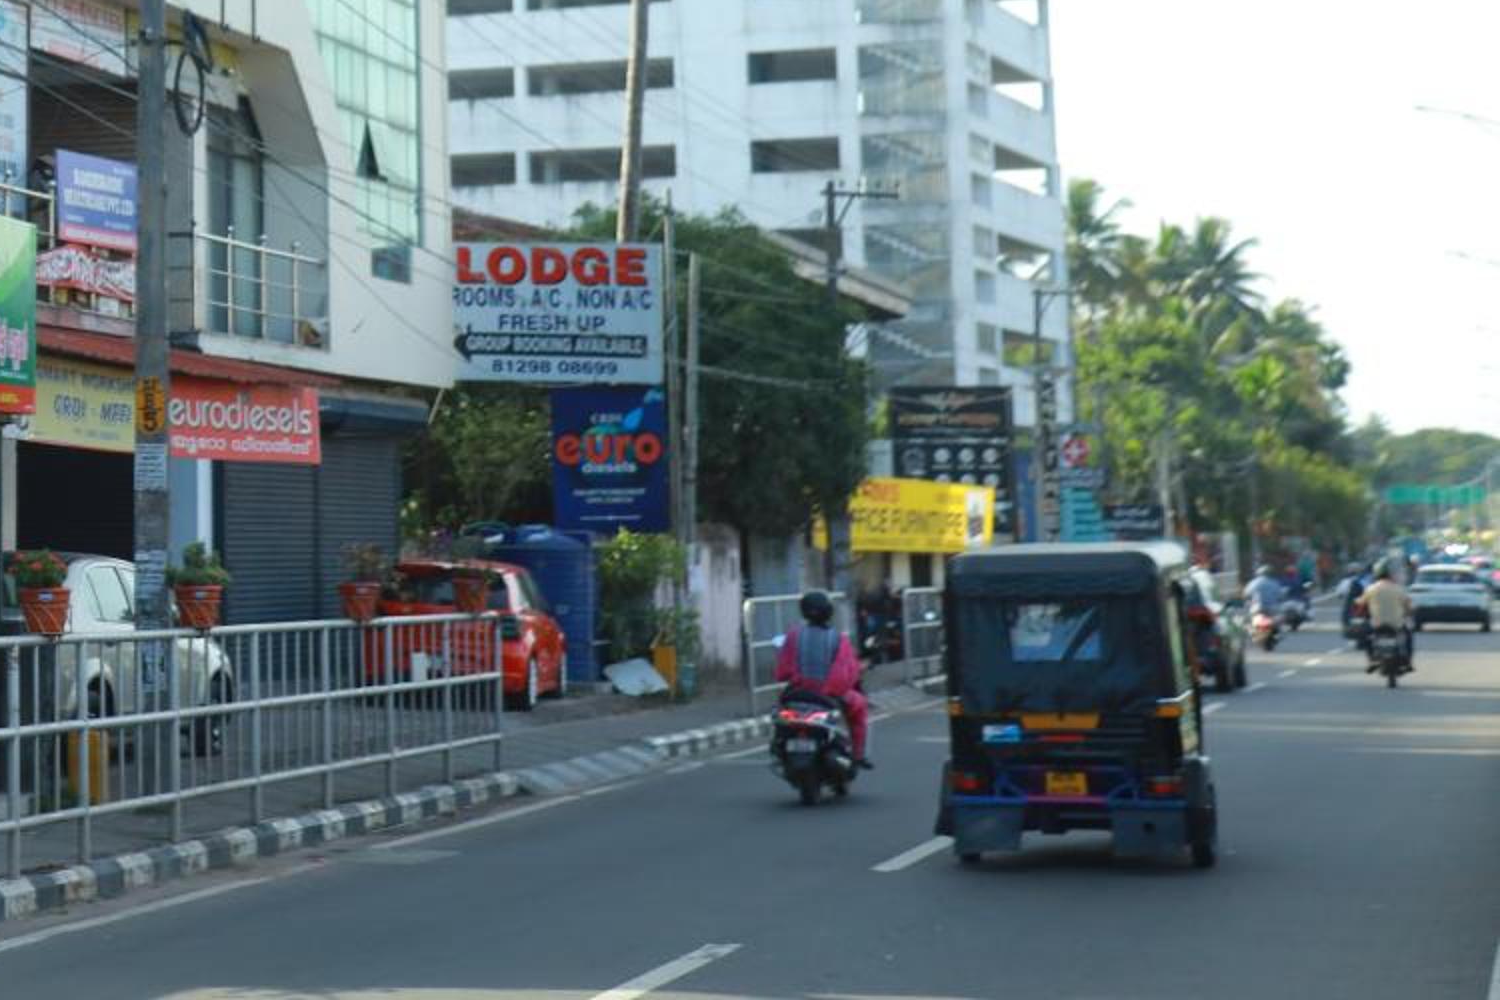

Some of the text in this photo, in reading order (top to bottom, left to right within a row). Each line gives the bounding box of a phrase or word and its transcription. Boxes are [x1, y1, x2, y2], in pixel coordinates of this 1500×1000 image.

[456, 246, 649, 287] LODGE
[576, 289, 616, 309] NON
[498, 314, 607, 332] FRESH UP
[168, 391, 313, 435] eurodiesels
[555, 431, 665, 466] euro
